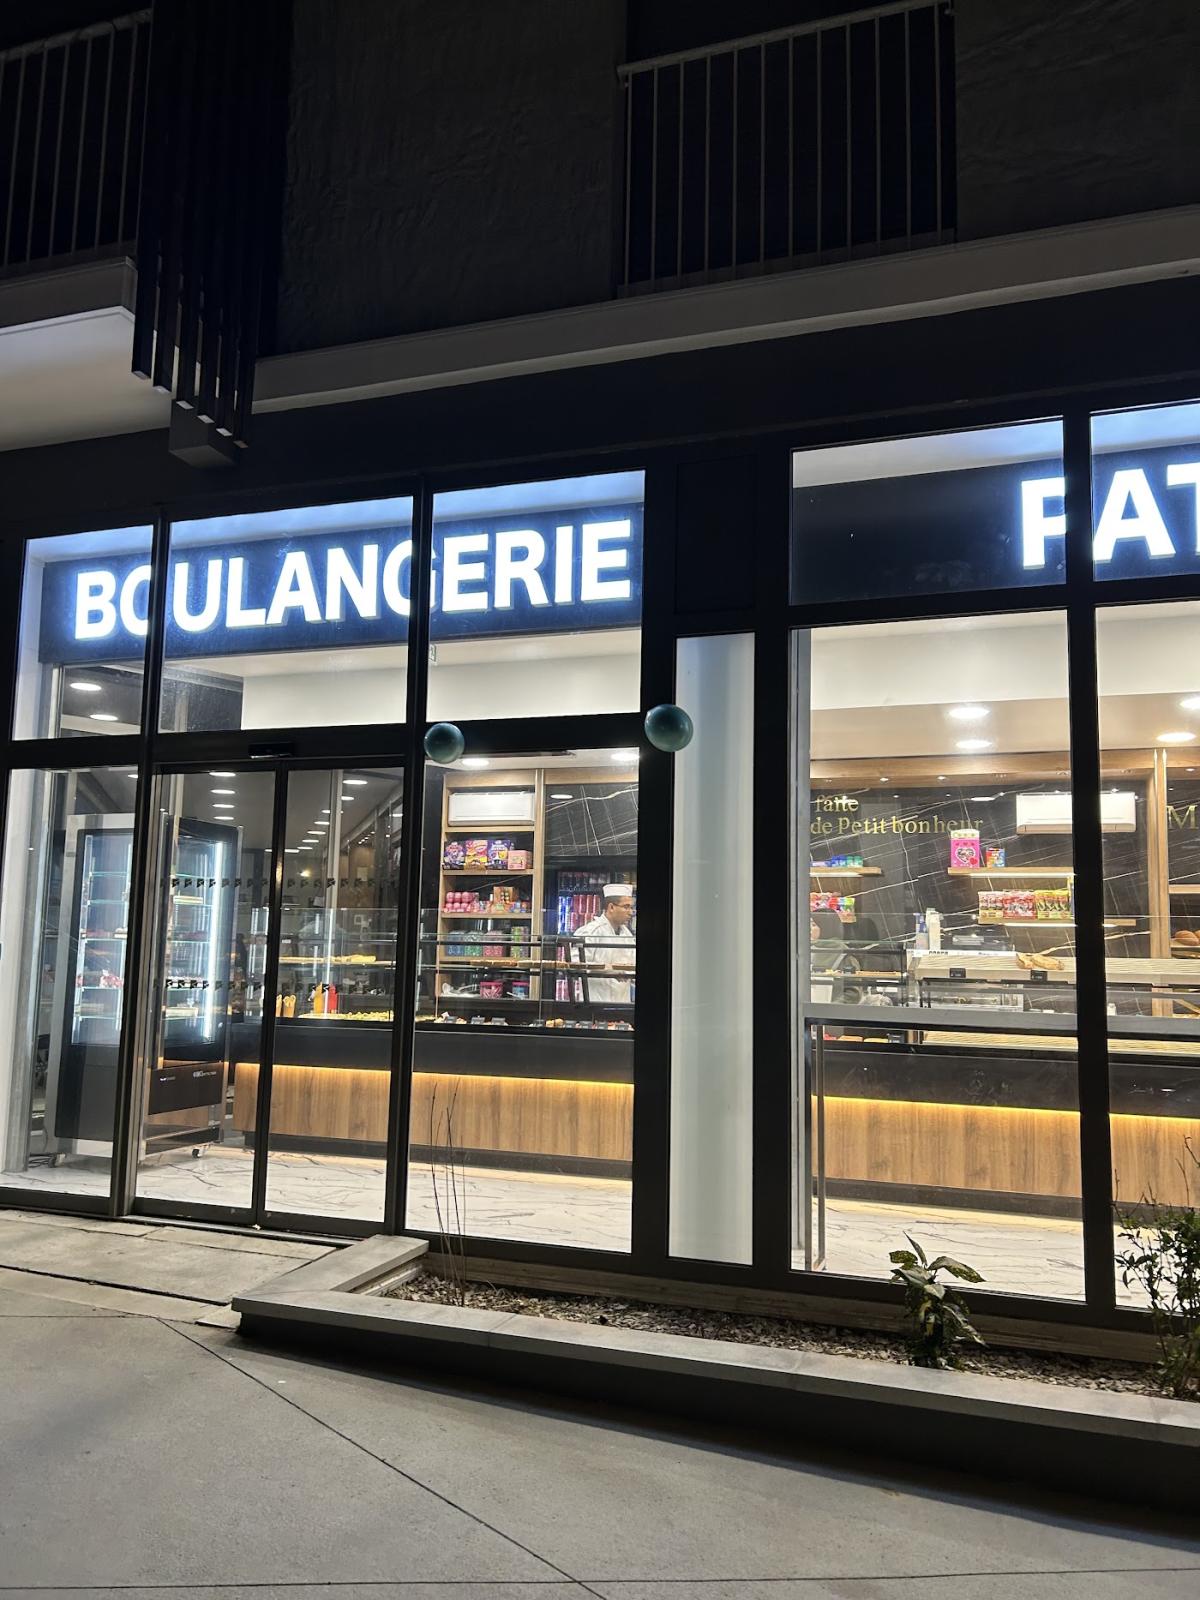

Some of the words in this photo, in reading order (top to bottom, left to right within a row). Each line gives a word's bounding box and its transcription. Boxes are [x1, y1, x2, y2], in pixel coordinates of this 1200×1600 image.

[75, 519, 631, 640] BOULANGERIE
[810, 816, 833, 834] de
[838, 816, 887, 835] Petit
[891, 815, 984, 834] bonheur
